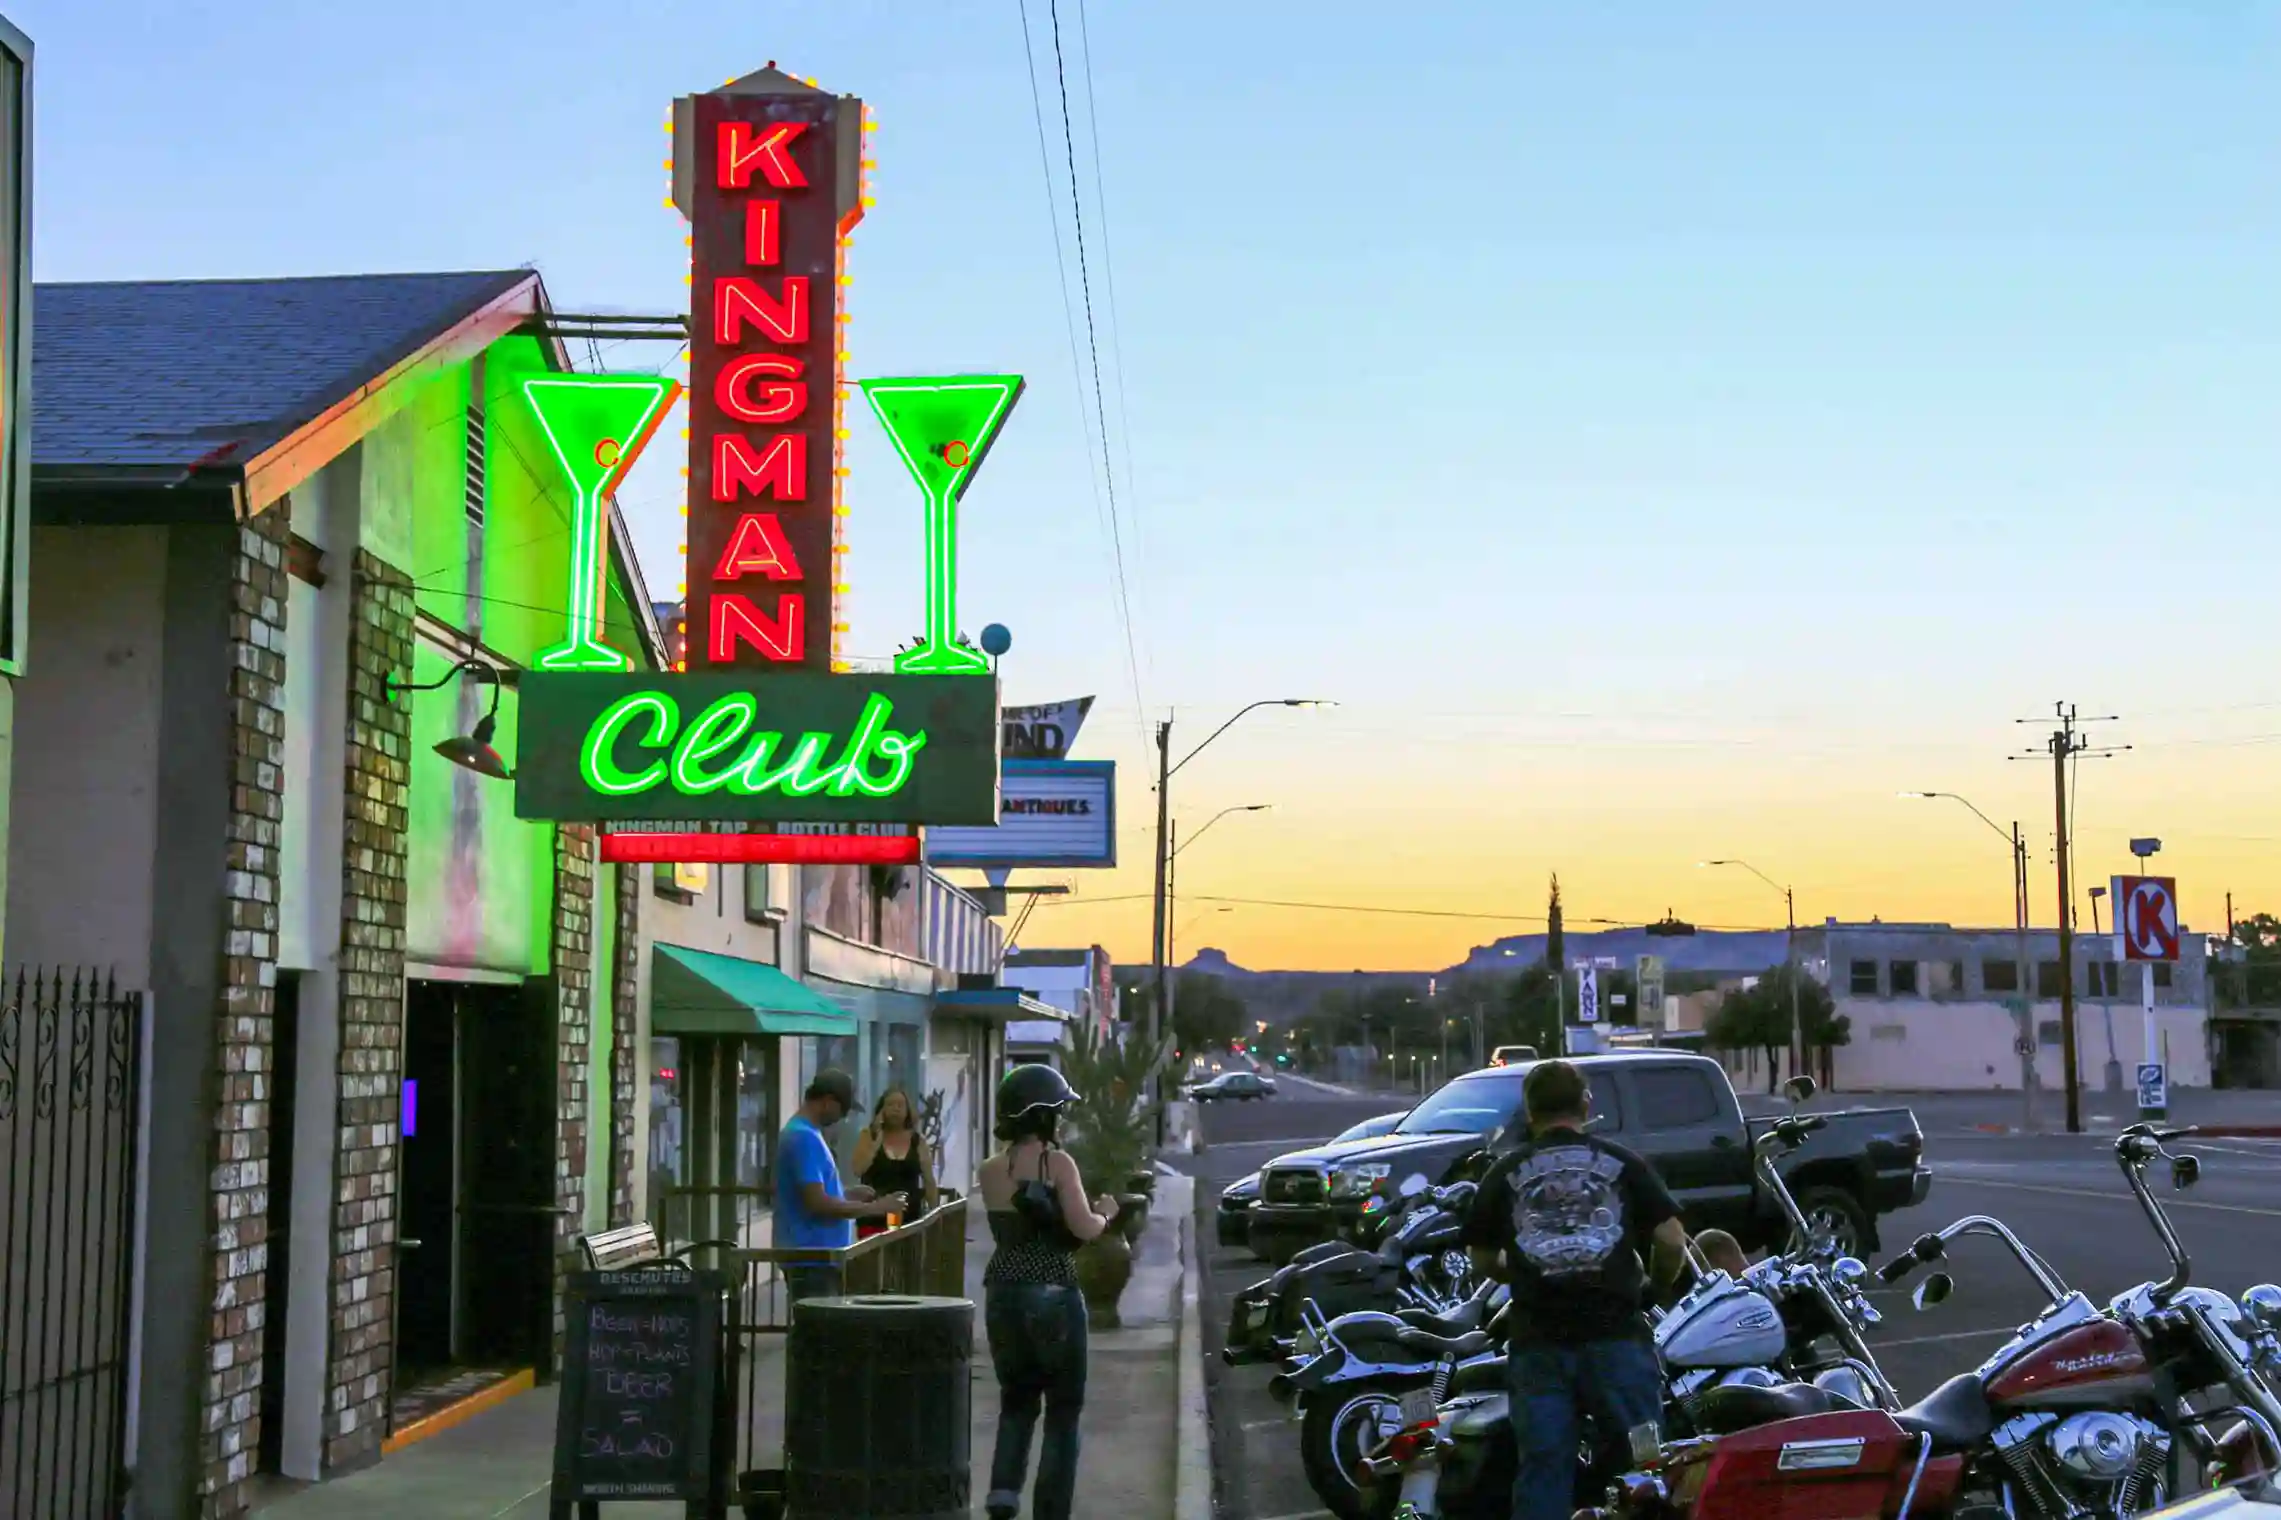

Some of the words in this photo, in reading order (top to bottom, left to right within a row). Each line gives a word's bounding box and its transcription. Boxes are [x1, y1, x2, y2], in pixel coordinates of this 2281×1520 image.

[708, 121, 809, 662] KINGMAN
[580, 691, 927, 797] Club
[605, 820, 701, 834] KINGMAN
[709, 820, 749, 834] TAP
[776, 821, 849, 837] BOTTLE
[855, 822, 909, 837] CLUB
